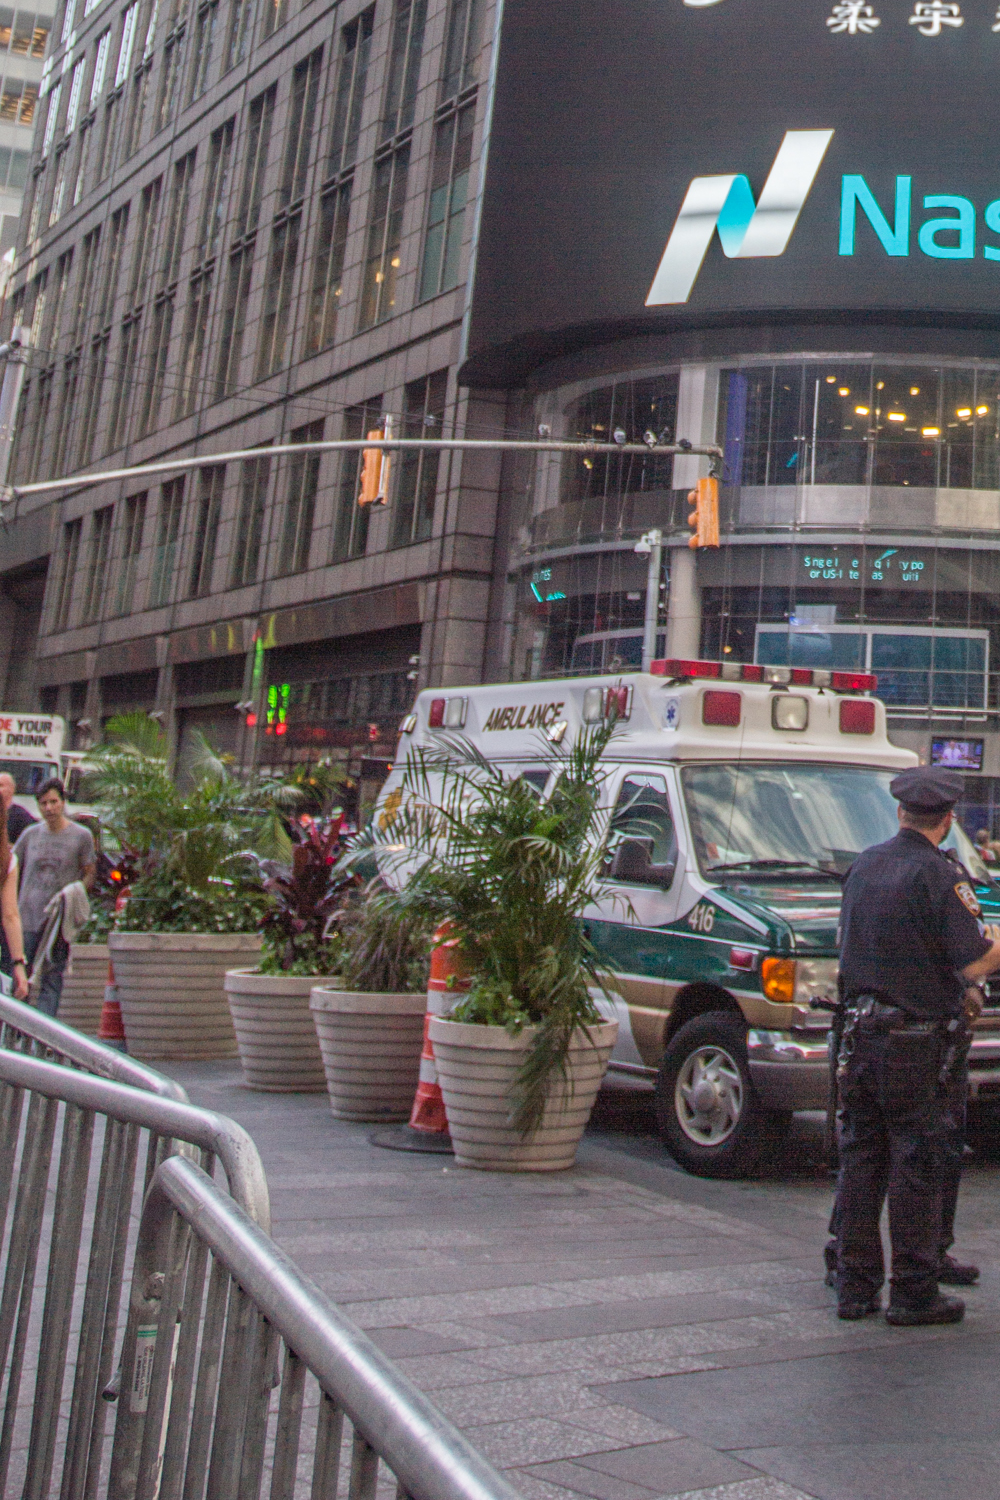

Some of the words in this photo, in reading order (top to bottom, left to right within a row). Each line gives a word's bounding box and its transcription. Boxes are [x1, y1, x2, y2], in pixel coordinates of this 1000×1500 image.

[17, 720, 52, 733] YOUR
[482, 702, 565, 732] AMBULANCE
[6, 733, 48, 747] DRINK
[688, 904, 715, 933] 416
